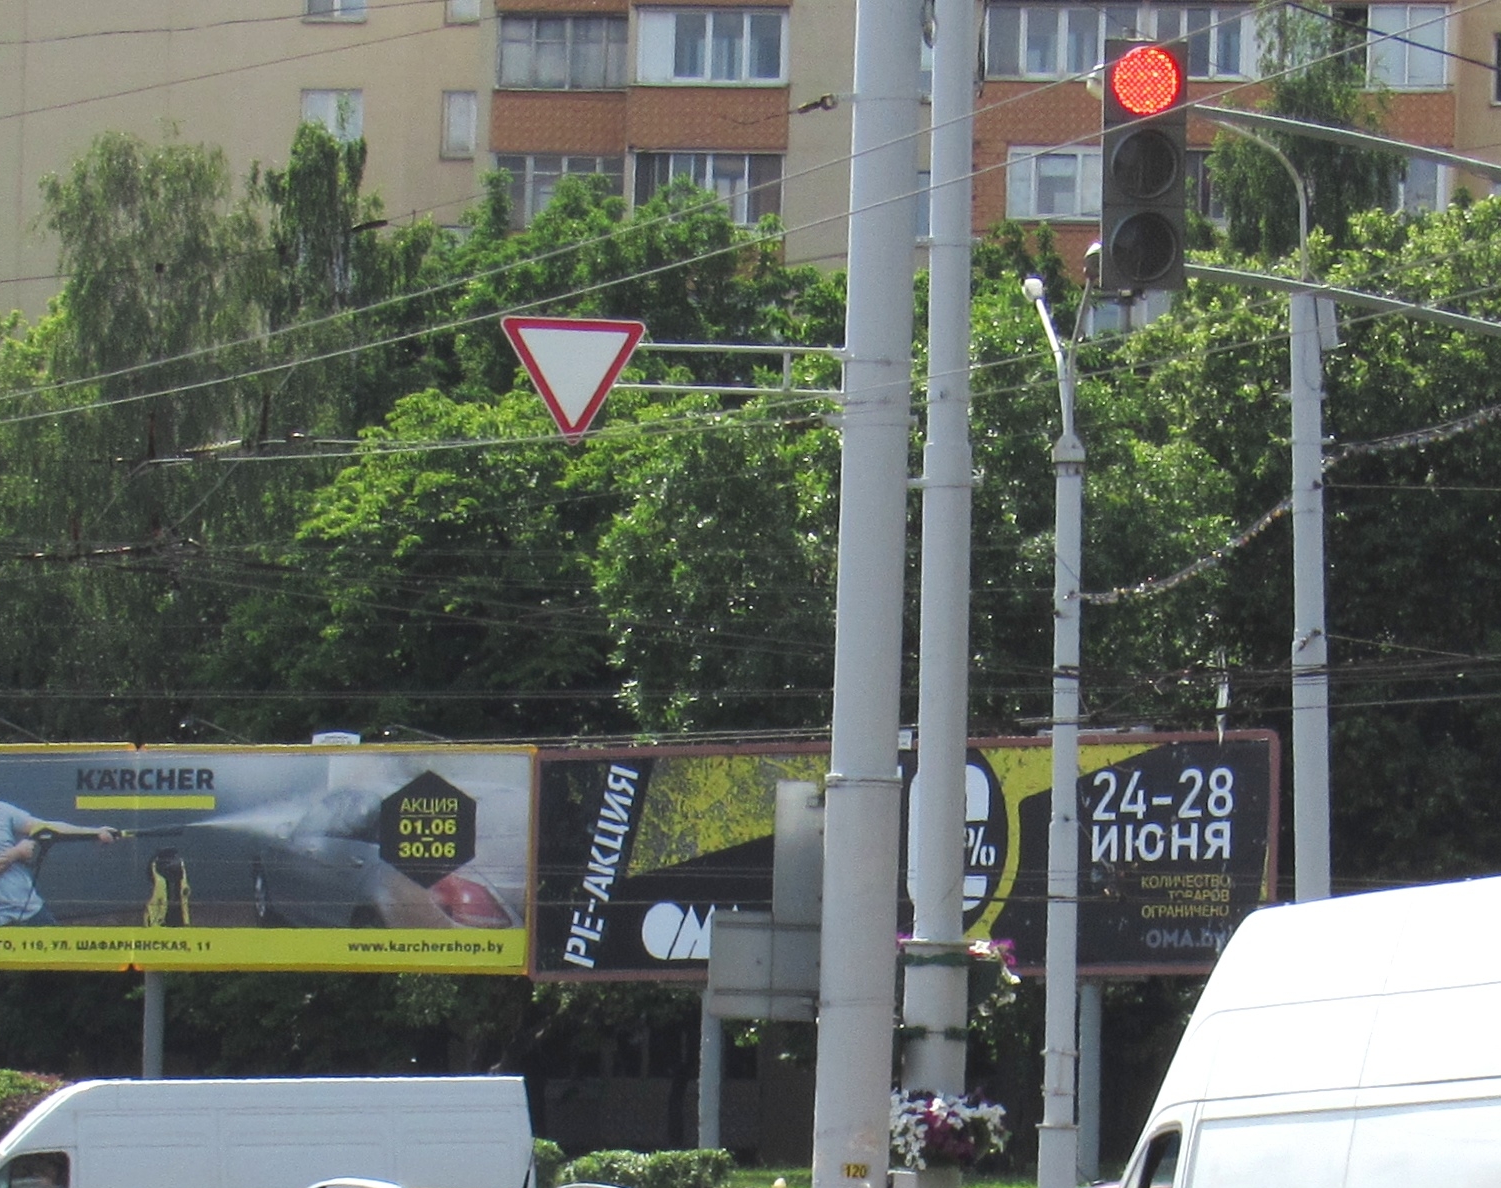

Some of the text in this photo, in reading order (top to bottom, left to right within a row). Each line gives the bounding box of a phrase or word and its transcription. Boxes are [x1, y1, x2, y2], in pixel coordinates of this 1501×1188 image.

[76, 767, 215, 790] KÄRCHER
[1092, 766, 1234, 821] 24-28
[400, 797, 458, 814] АКЦИЯ
[399, 818, 457, 835] 01.06
[399, 841, 456, 858] 30.06
[1091, 820, 1232, 863] ИЮНЯ
[563, 764, 639, 969] РЕ-АКЦИЯ
[1141, 873, 1231, 889] КОЛИЧЕСТВО
[1141, 904, 1230, 919] ОГРАНИЧЕНО
[52, 940, 71, 951] УЛ.
[197, 940, 211, 951] 11
[348, 940, 504, 955] www.karchershop.by
[845, 1165, 866, 1178] 120
